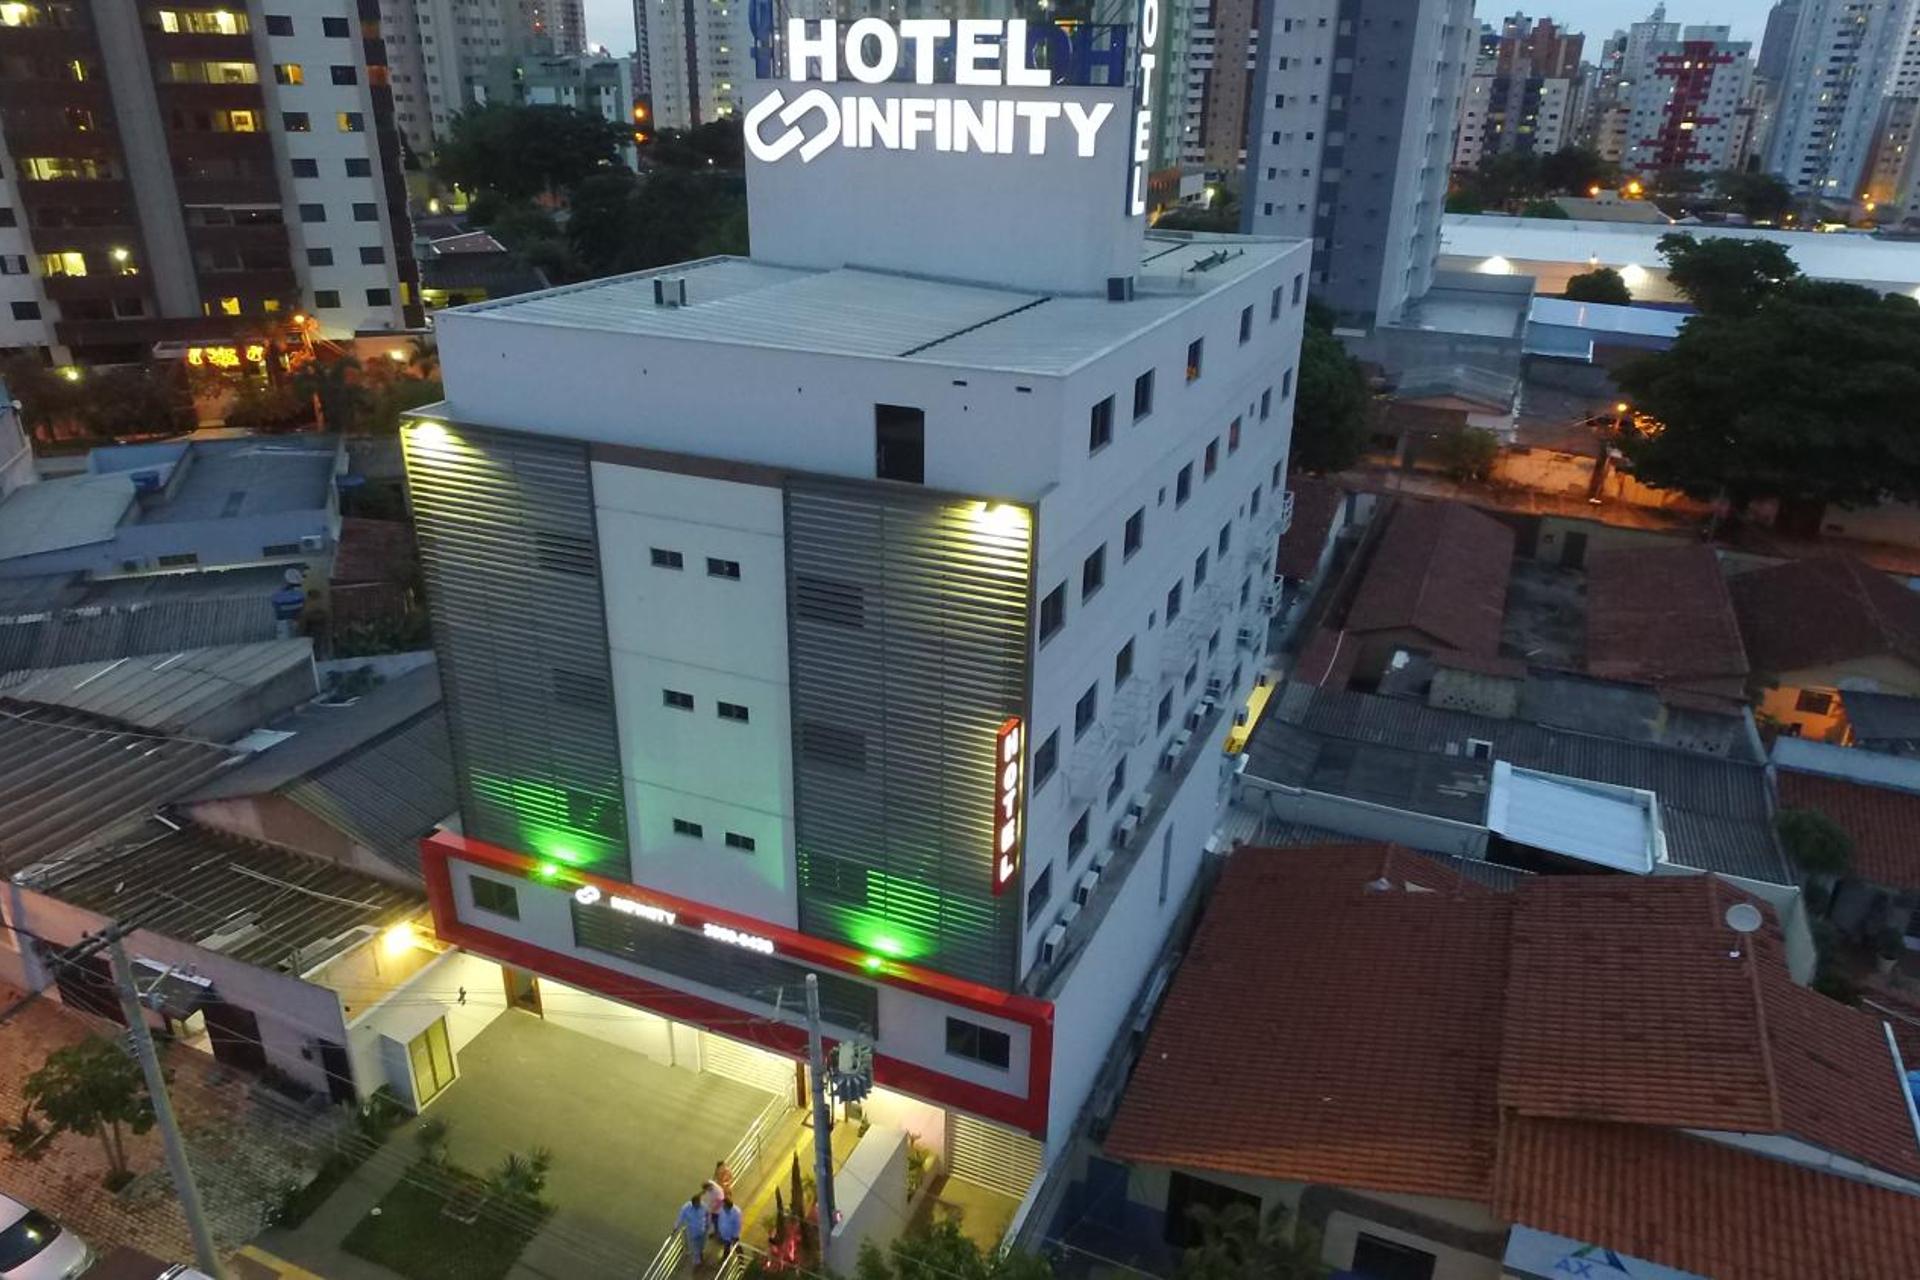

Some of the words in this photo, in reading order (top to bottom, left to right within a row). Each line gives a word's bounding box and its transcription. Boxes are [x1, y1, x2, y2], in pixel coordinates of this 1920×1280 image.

[788, 17, 1052, 86] HOTEL
[842, 96, 1114, 157] INFINITY
[1000, 727, 1019, 883] HOTEL
